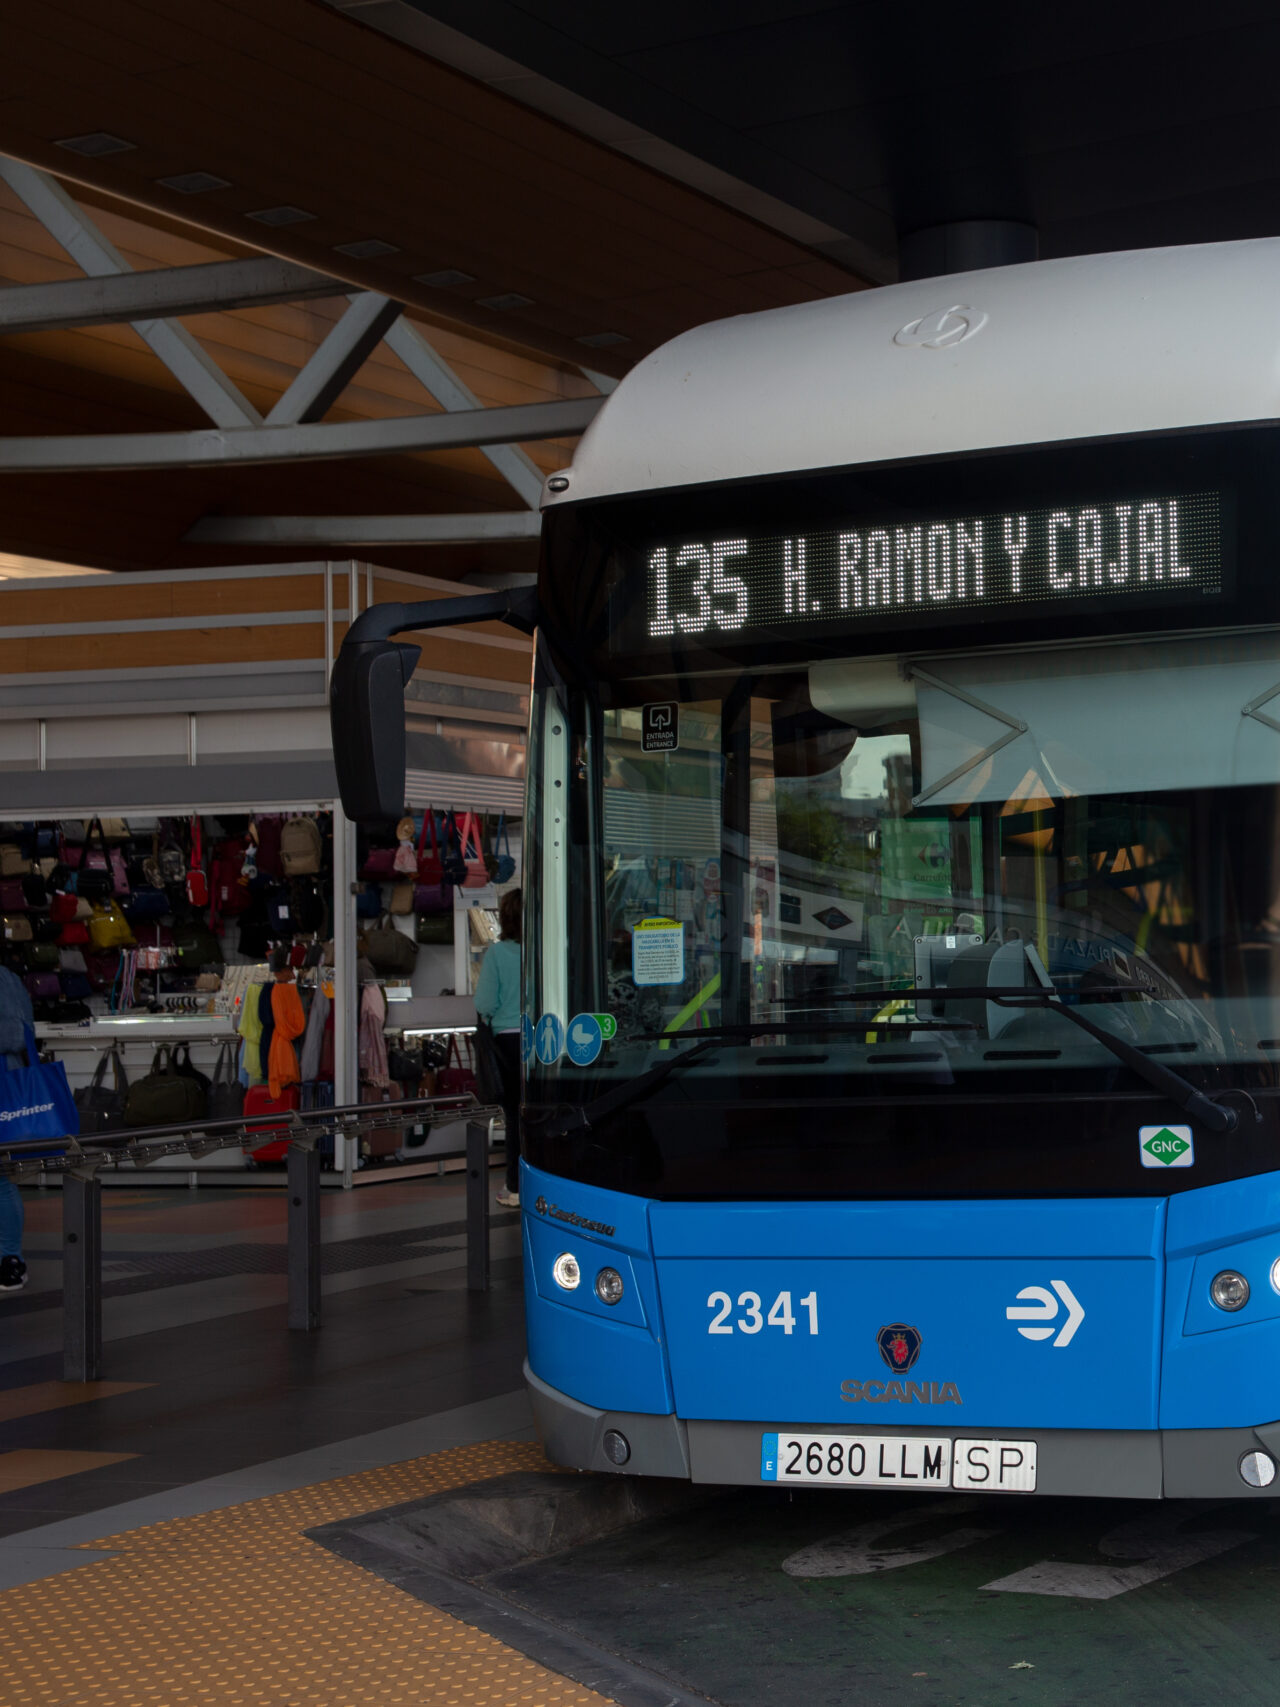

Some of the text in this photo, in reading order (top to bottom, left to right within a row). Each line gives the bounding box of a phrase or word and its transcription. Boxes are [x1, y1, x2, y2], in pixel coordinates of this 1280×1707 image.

[783, 500, 1191, 614] H. RAMON Y CAJAL
[648, 538, 748, 637] 135
[646, 731, 674, 740] ENTRADA
[646, 740, 674, 749] ENTRANCE
[603, 1017, 612, 1033] 3
[0, 1102, 55, 1122] Sprinter
[1151, 1140, 1182, 1153] GNC
[706, 1291, 819, 1335] 2341
[840, 1379, 963, 1405] SCANIA
[765, 1441, 944, 1480] E 2680 LLM
[967, 1446, 1024, 1484] SP
